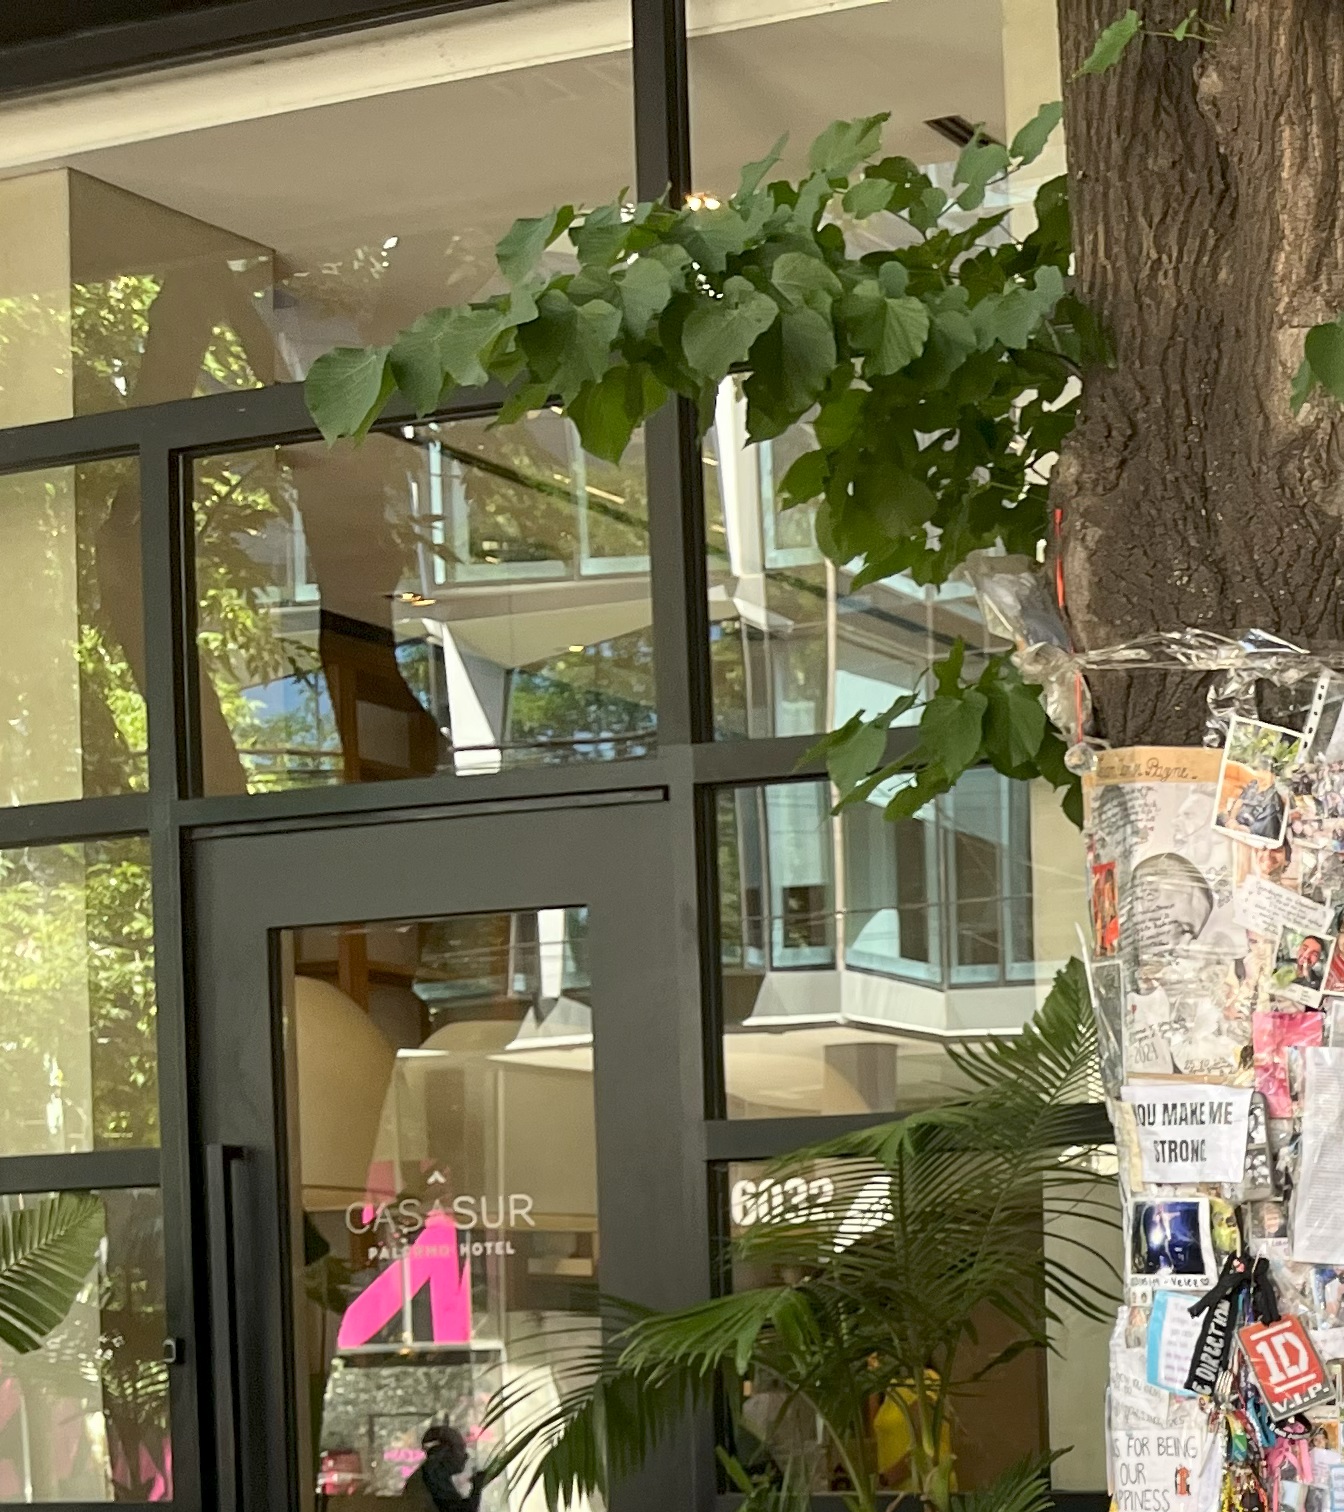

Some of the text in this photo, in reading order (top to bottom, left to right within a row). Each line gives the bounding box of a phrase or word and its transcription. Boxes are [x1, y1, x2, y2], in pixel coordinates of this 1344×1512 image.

[1162, 1102, 1205, 1126] MAKE
[1209, 1101, 1233, 1125] ME
[459, 1241, 516, 1257] HOTEL
[1256, 1332, 1309, 1384] 1D
[1272, 1382, 1330, 1414] V.I.P.
[1127, 1437, 1150, 1457] FOR
[1157, 1435, 1198, 1458] BEING
[1120, 1463, 1146, 1486] OUR
